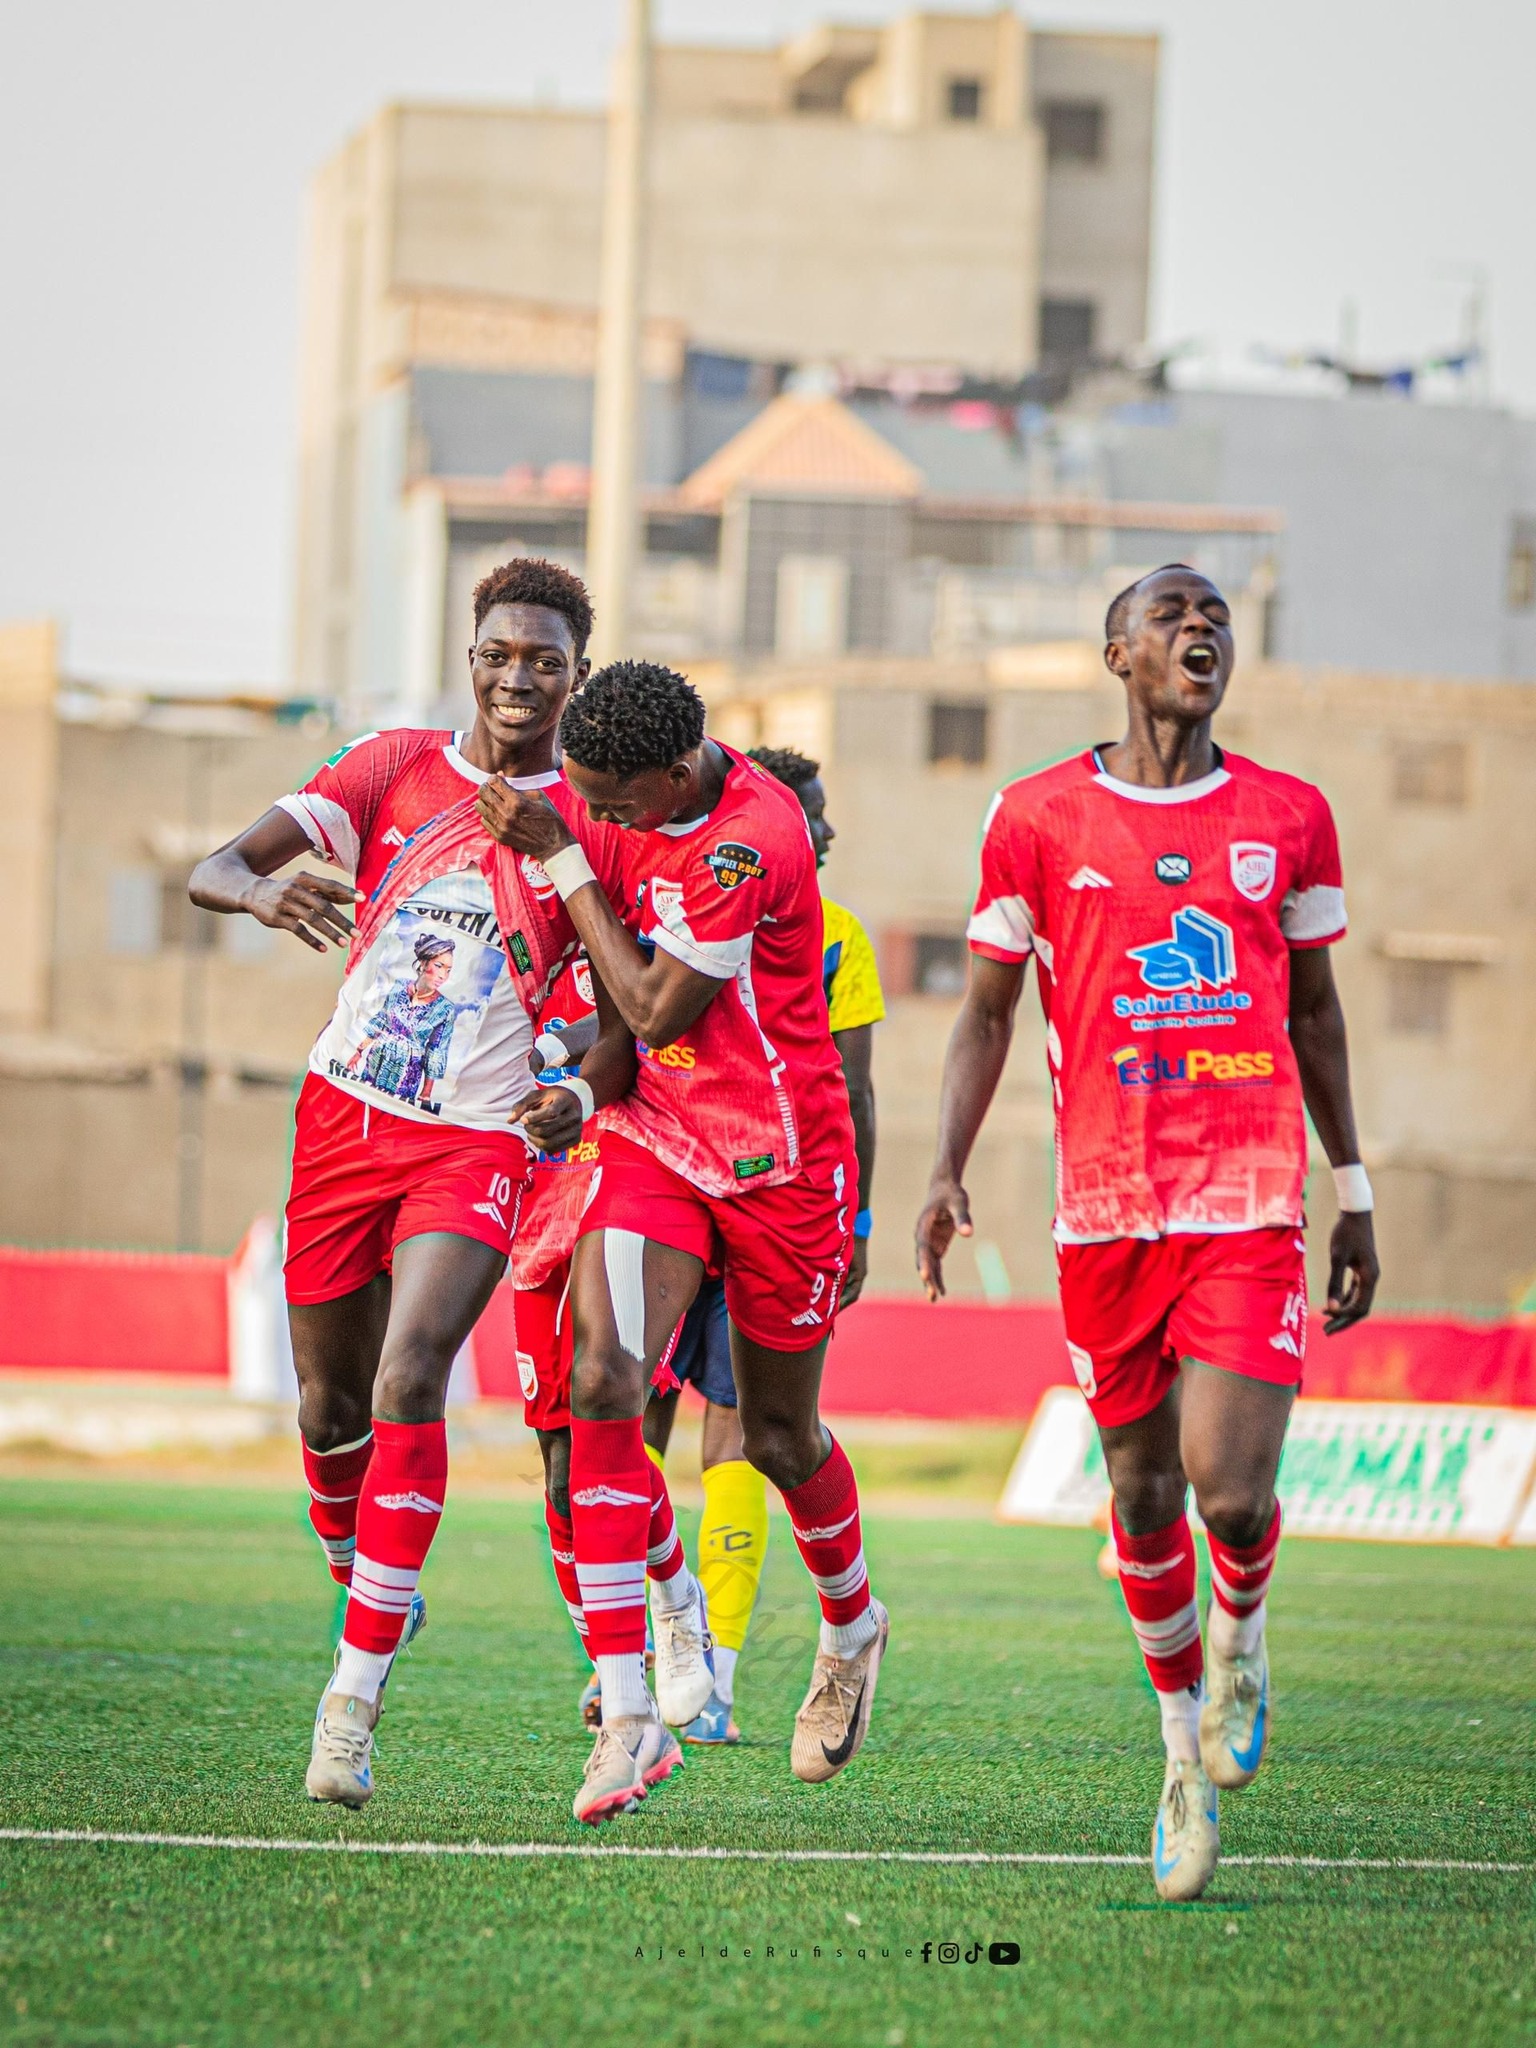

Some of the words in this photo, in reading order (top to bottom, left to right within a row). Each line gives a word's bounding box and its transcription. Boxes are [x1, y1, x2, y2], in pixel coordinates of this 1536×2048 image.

[720, 869, 738, 887] 99
[1114, 990, 1252, 1016] SoluEtude
[1117, 1049, 1275, 1085] EduPass
[486, 1172, 510, 1206] 10
[809, 1272, 825, 1305] 9
